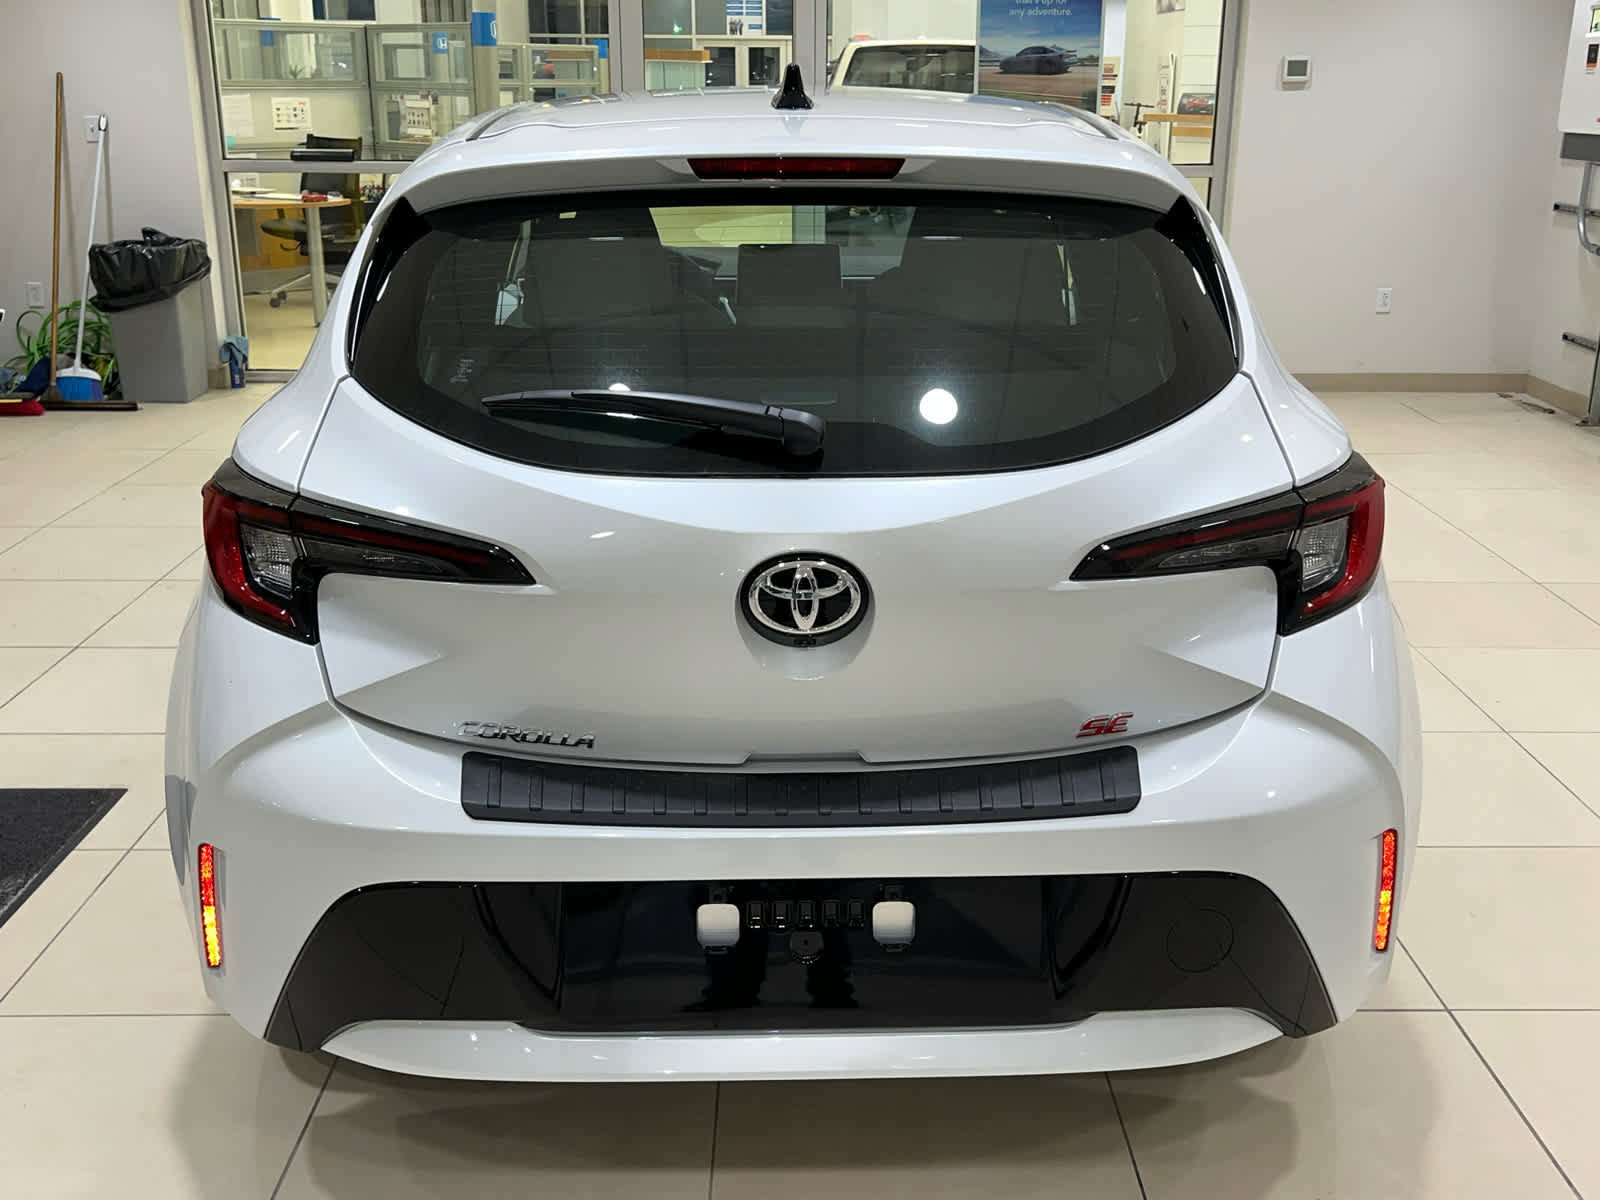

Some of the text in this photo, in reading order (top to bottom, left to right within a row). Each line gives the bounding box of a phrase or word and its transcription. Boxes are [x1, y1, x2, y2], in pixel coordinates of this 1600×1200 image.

[1008, 7, 1073, 18] any adventure.
[457, 720, 596, 749] COROLLA
[1075, 712, 1134, 739] SE
